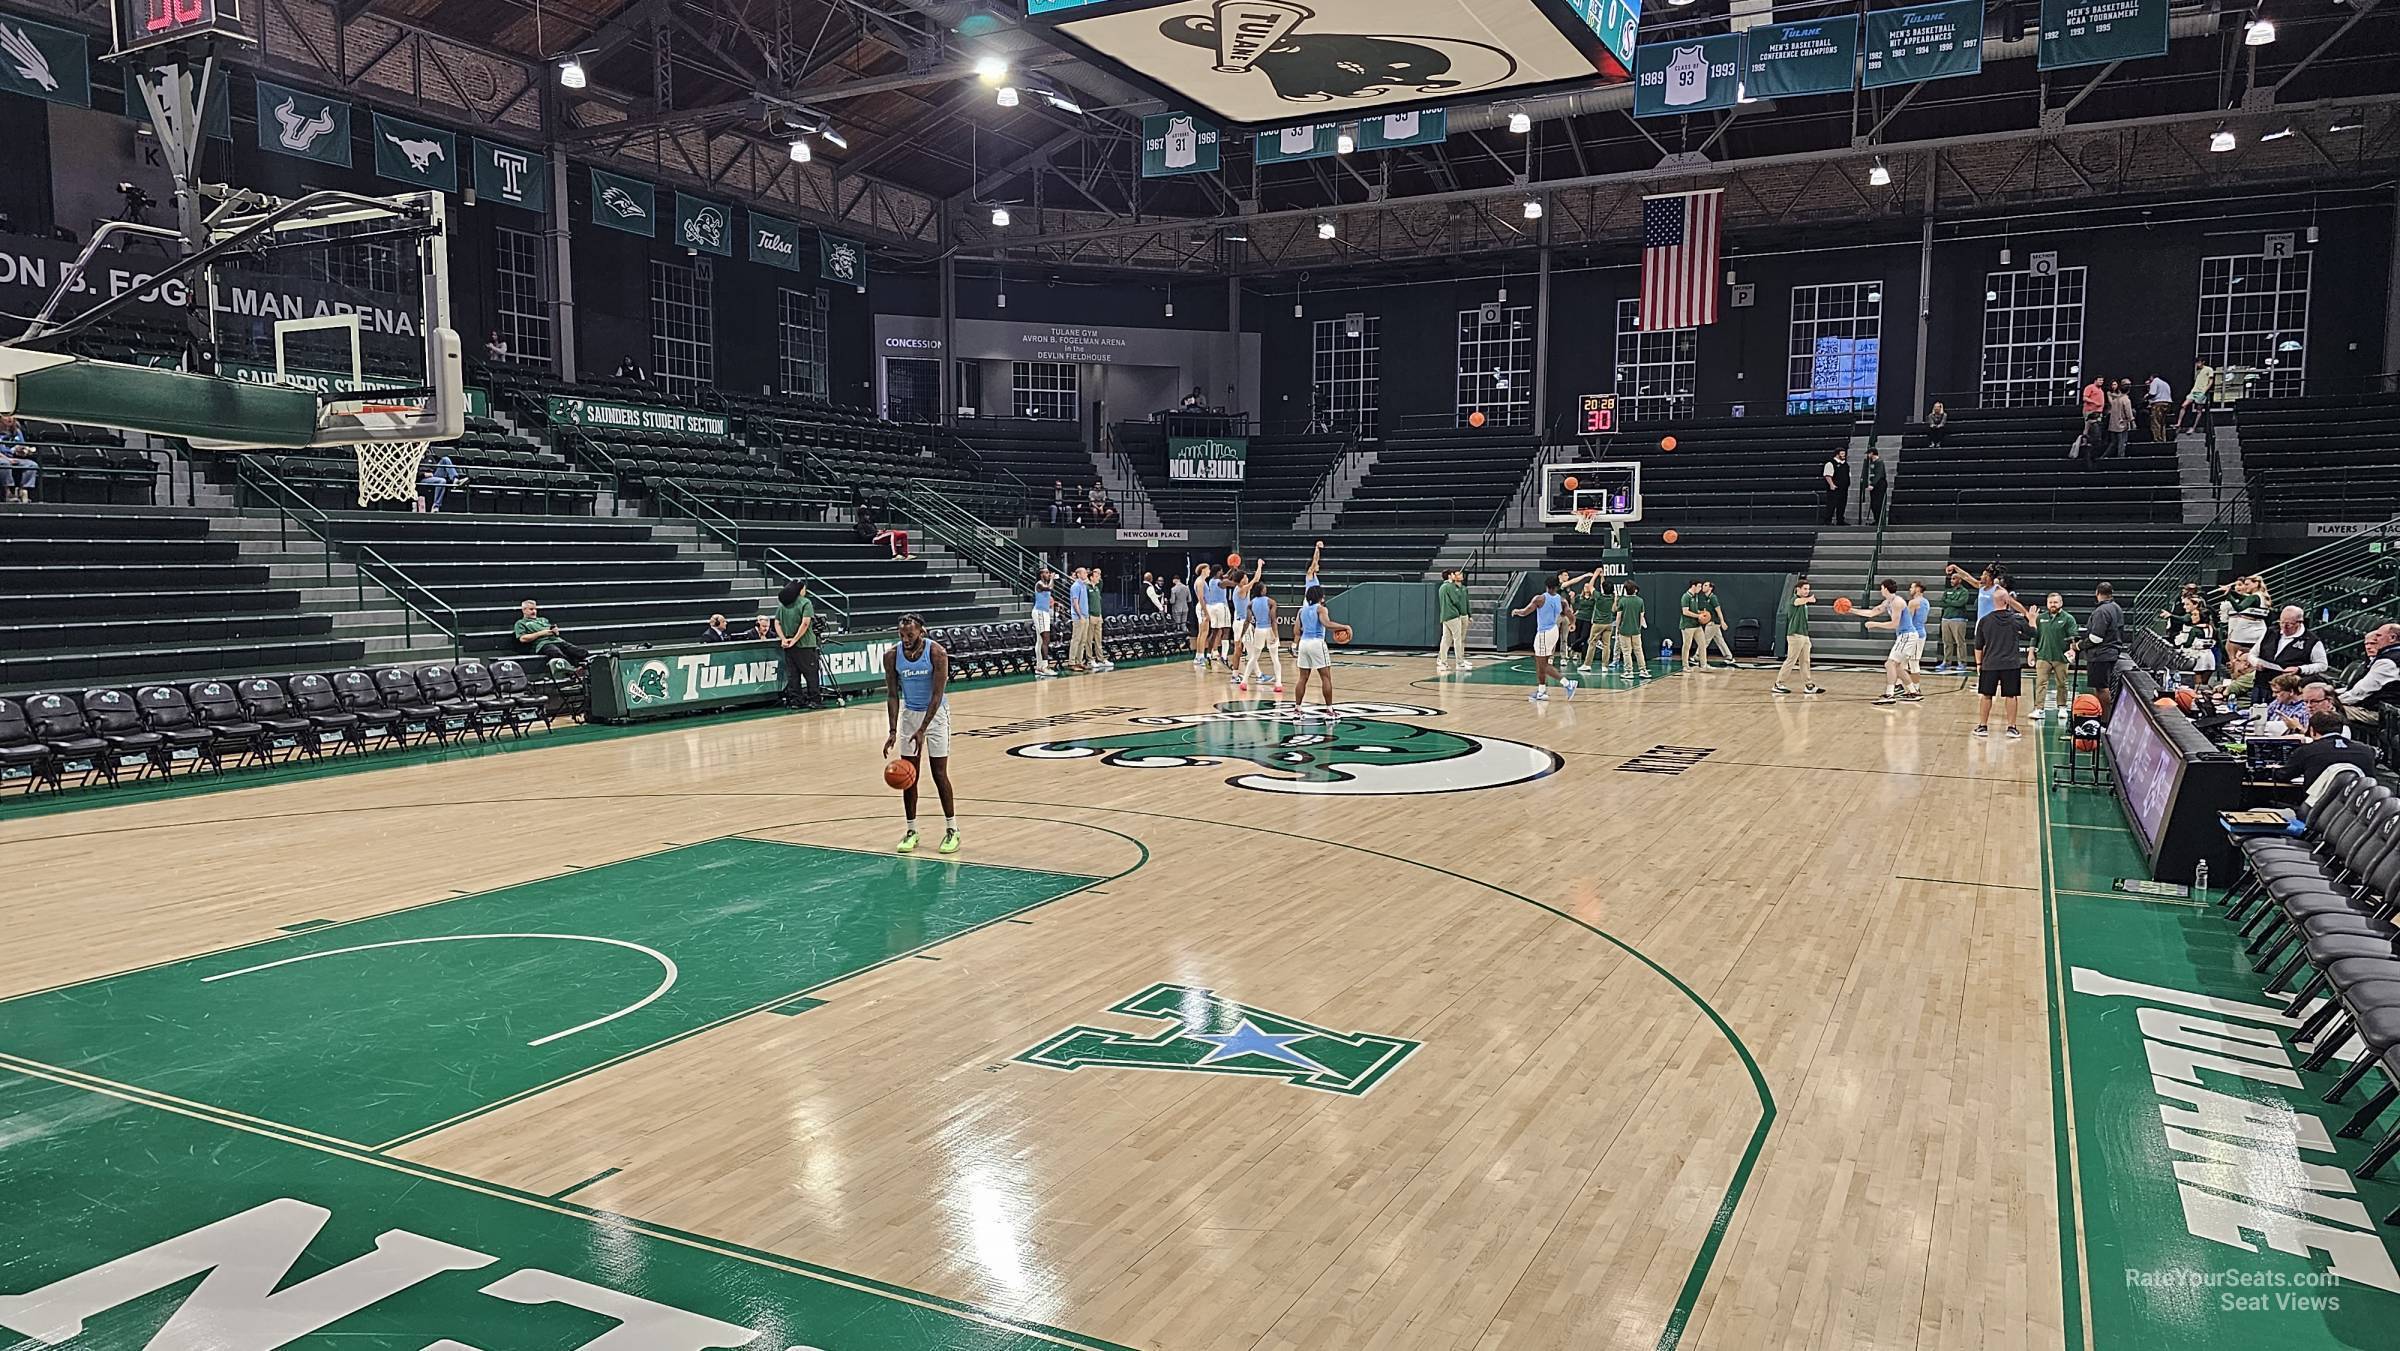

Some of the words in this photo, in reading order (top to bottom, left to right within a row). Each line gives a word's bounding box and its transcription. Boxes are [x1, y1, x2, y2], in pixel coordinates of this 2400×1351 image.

[2066, 7, 2090, 17] MEN'S
[2092, 0, 2139, 14] BASKETBALL
[2066, 15, 2087, 26] NCAA
[2089, 9, 2139, 23] TOURNAMENT
[1230, 13, 1281, 60] TULANE
[1889, 29, 1911, 39] MEN'S
[1912, 24, 1956, 35] BASKETBALL
[1769, 43, 1790, 52] MEN'S
[1791, 38, 1832, 50] BASKETBALL
[1889, 39, 1901, 47] NIT
[1903, 32, 1952, 45] APPEARANCES
[1760, 50, 1798, 61] CONFERENCE
[1800, 46, 1838, 57] CHAMPIONS
[1711, 62, 1735, 78] 1993
[1640, 71, 1664, 86] 1989
[1679, 70, 1695, 87] 93
[1146, 138, 1164, 151] 1967
[1175, 138, 1186, 151] 31
[1198, 131, 1216, 145] 1969
[145, 147, 160, 167] K
[756, 229, 793, 255] Tulsa
[2273, 242, 2285, 257] R
[2036, 259, 2051, 276] Q
[1738, 291, 1748, 304] P
[1485, 309, 1496, 321] O
[1051, 328, 1080, 337] TULANE
[1082, 329, 1098, 337] GYM
[1022, 335, 1048, 343] AVRON
[1059, 336, 1099, 346] FOGELMAN
[1101, 338, 1126, 346] ARENA
[1037, 351, 1064, 360] DEVLIN
[1065, 353, 1112, 362] FIELDHOUSE
[586, 405, 640, 426] SAUNDERS
[642, 410, 684, 431] STUDENT
[688, 415, 724, 435] SECTION
[1588, 410, 1611, 431] 30
[2317, 525, 2358, 534] PLAYERS
[1603, 564, 1629, 577] ROLL
[677, 653, 779, 700] TULANE
[902, 668, 929, 678] TULANE
[2070, 965, 2400, 1295] TULANE
